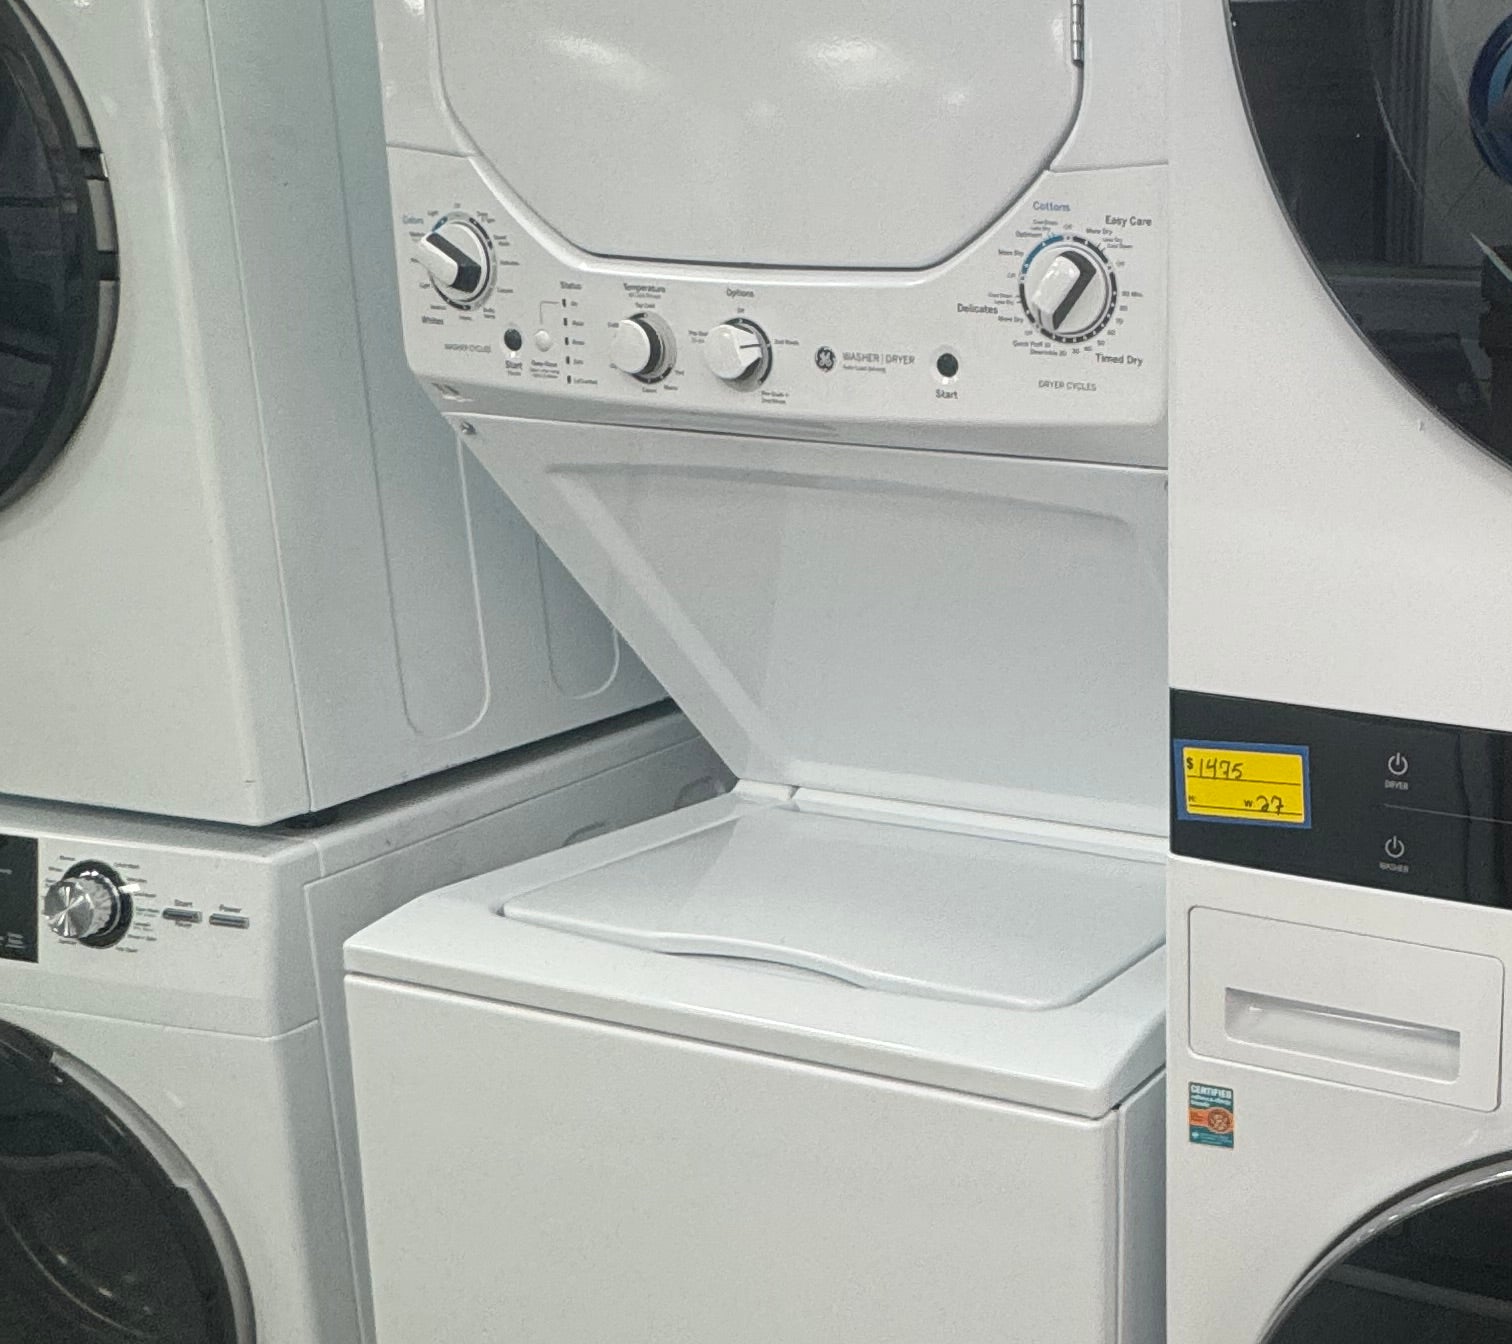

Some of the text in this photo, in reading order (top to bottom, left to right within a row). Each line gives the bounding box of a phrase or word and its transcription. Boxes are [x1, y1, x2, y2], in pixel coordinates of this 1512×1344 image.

[1032, 201, 1071, 212] Cottons
[1105, 215, 1152, 228] Easy Care
[726, 287, 755, 299] Options
[957, 303, 999, 314] Delicates
[885, 354, 916, 365] DRYER
[1095, 353, 1143, 368] Timed Dry
[935, 389, 958, 400] Start
[1256, 794, 1285, 816] 27
